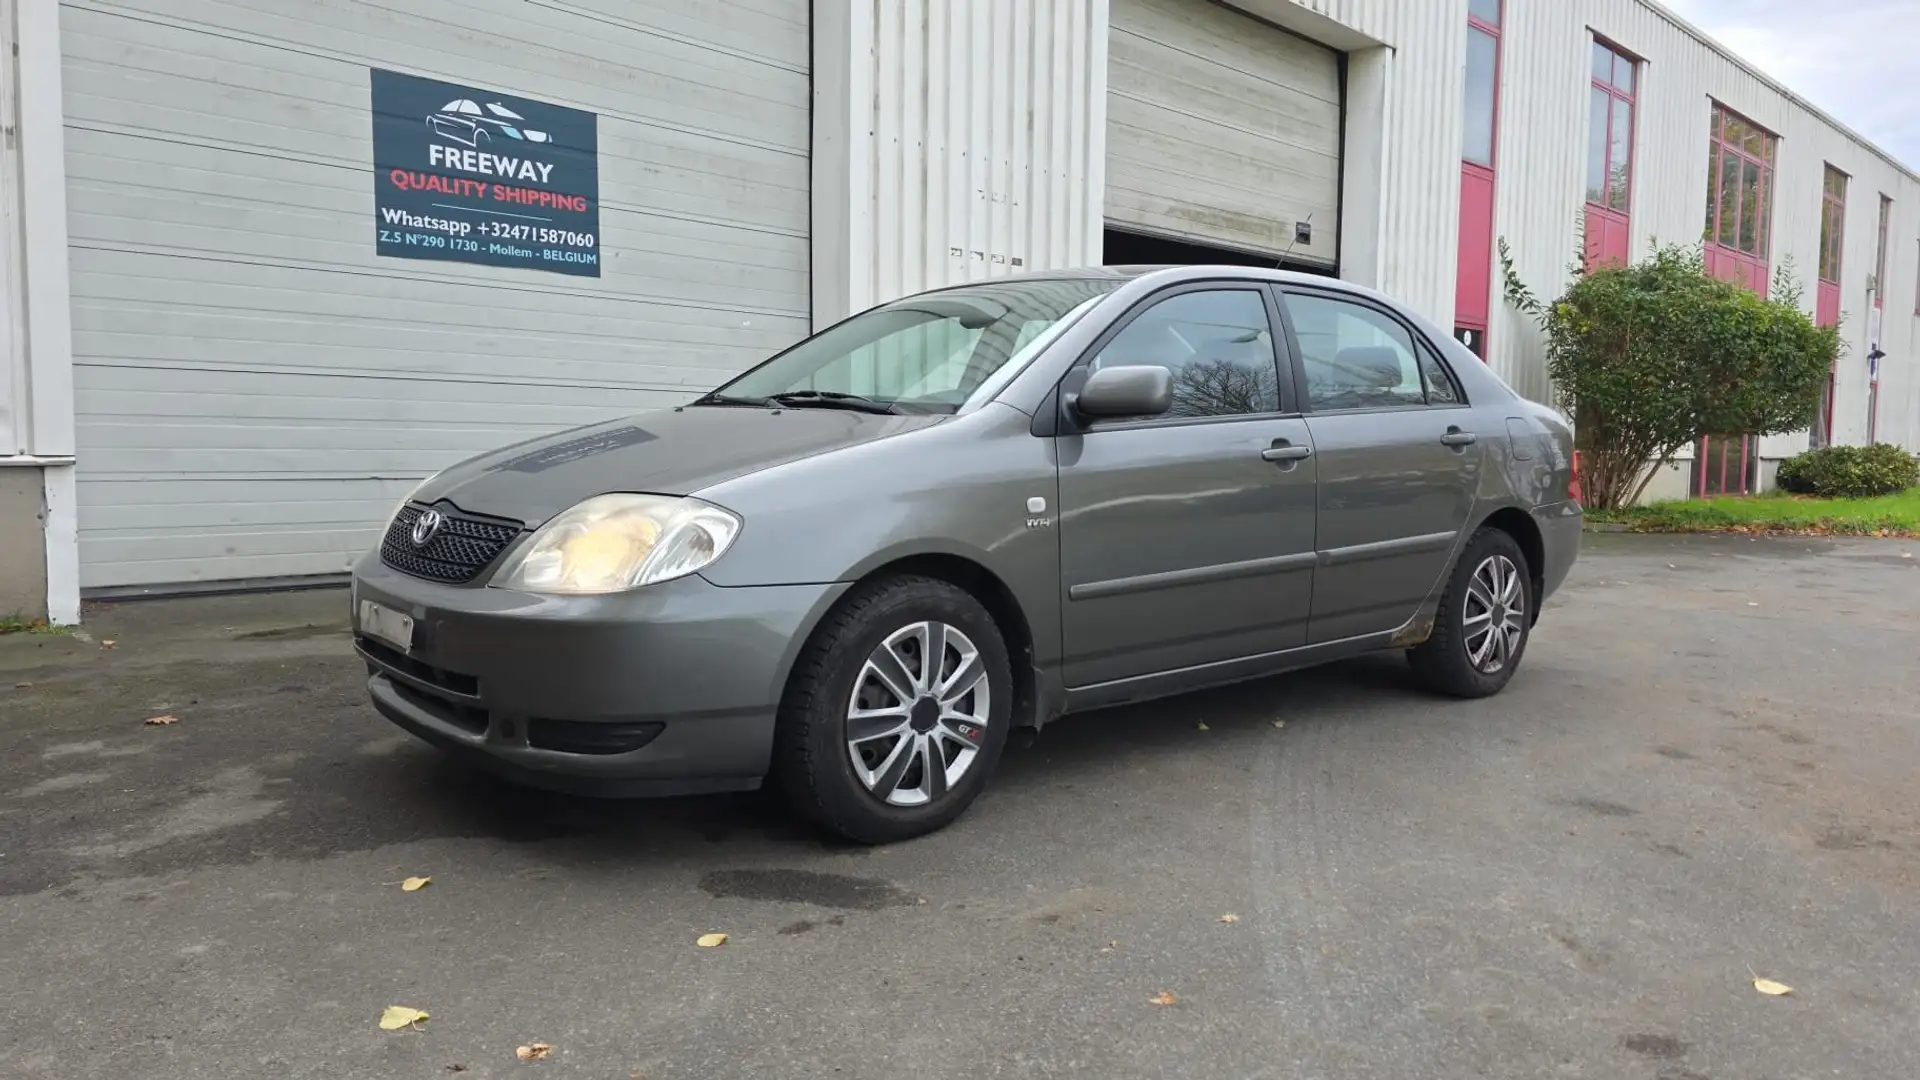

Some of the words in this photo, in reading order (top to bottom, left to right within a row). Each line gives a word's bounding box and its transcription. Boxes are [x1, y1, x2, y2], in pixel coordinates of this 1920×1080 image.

[429, 144, 553, 183] FREEWAY
[390, 168, 488, 198] QUALITY
[493, 184, 586, 212] SHIPPING
[381, 207, 471, 237] Whatsapp
[477, 222, 594, 248] +32471587060
[405, 233, 445, 248] N°290
[450, 238, 478, 252] 1730
[489, 243, 532, 258] Mollem
[543, 249, 597, 264] BELGIUM
